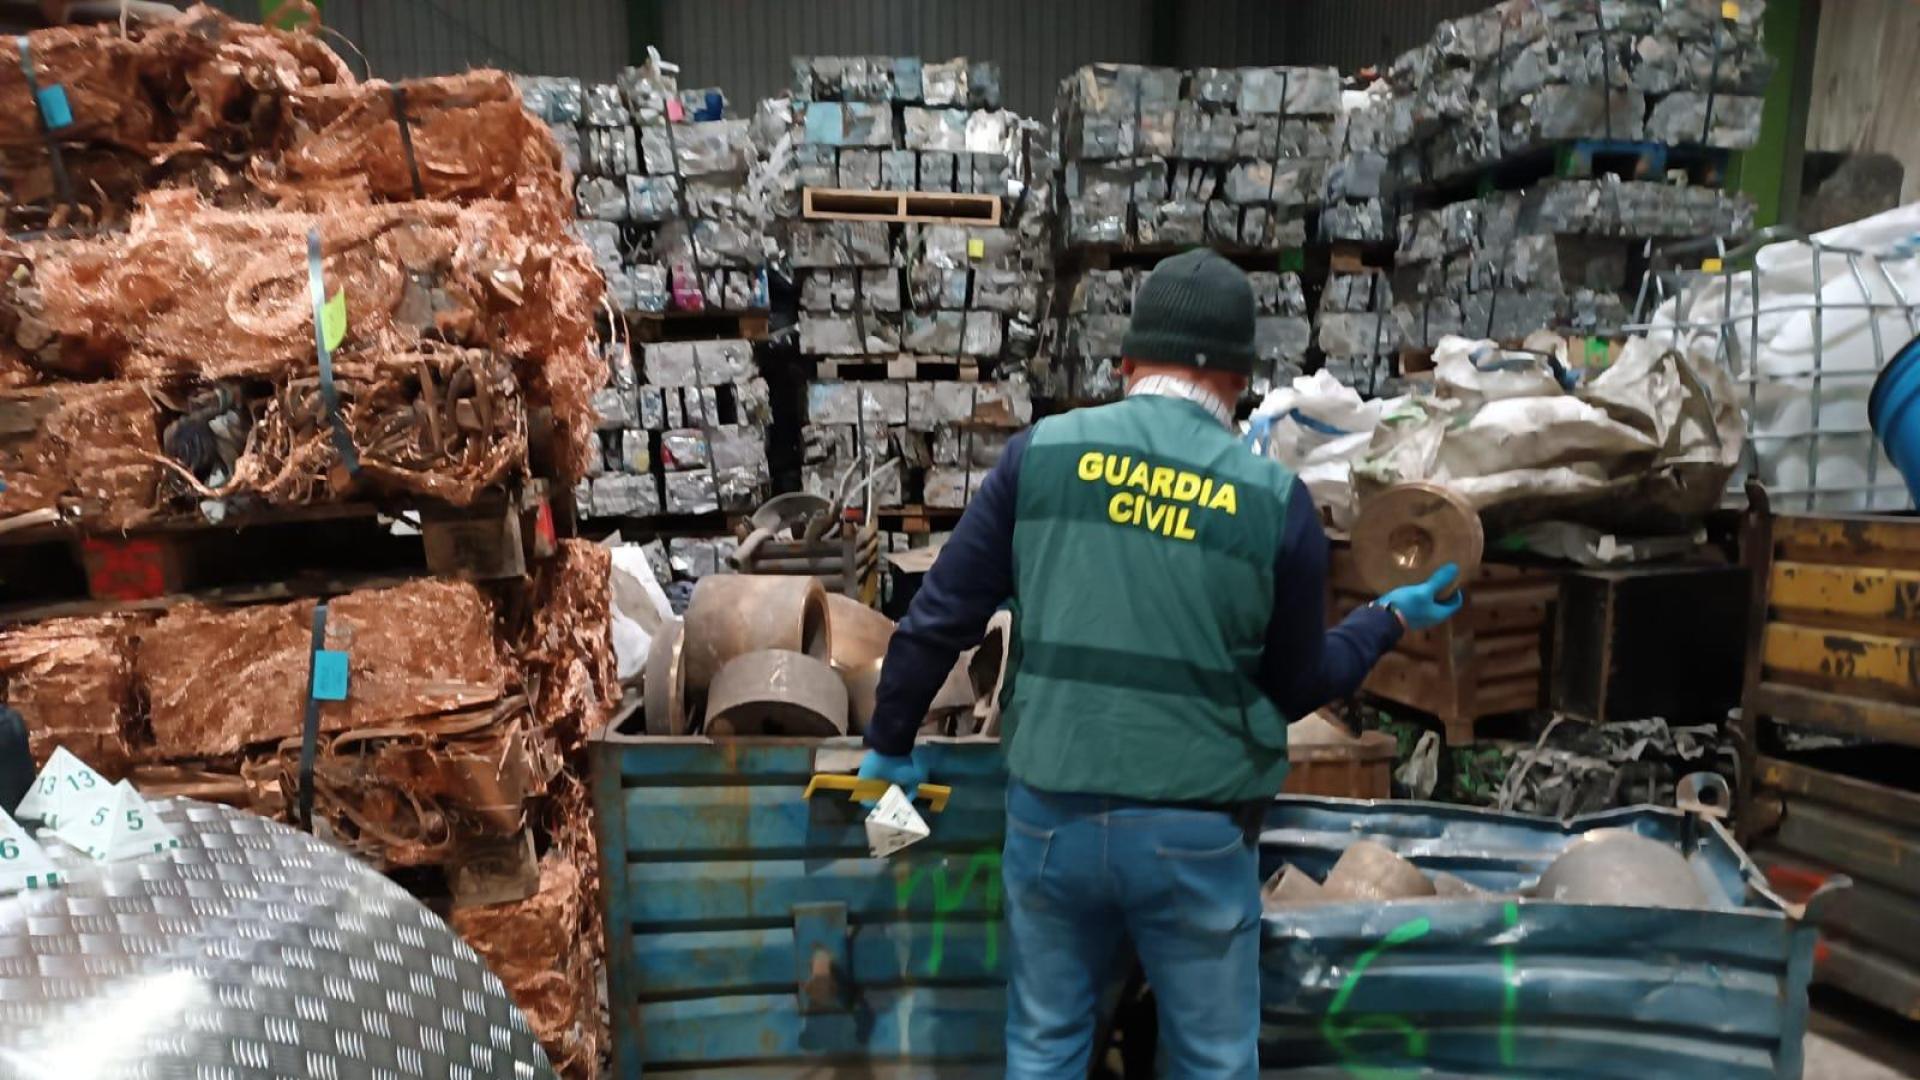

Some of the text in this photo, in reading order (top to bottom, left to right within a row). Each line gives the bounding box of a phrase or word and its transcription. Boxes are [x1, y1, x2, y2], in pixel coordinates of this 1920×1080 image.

[1078, 452, 1236, 515] GUARDIA
[1108, 492, 1196, 540] CIVIL
[67, 770, 96, 791] 13
[90, 806, 110, 826] 5
[126, 809, 144, 831] 5
[0, 838, 20, 859] 6
